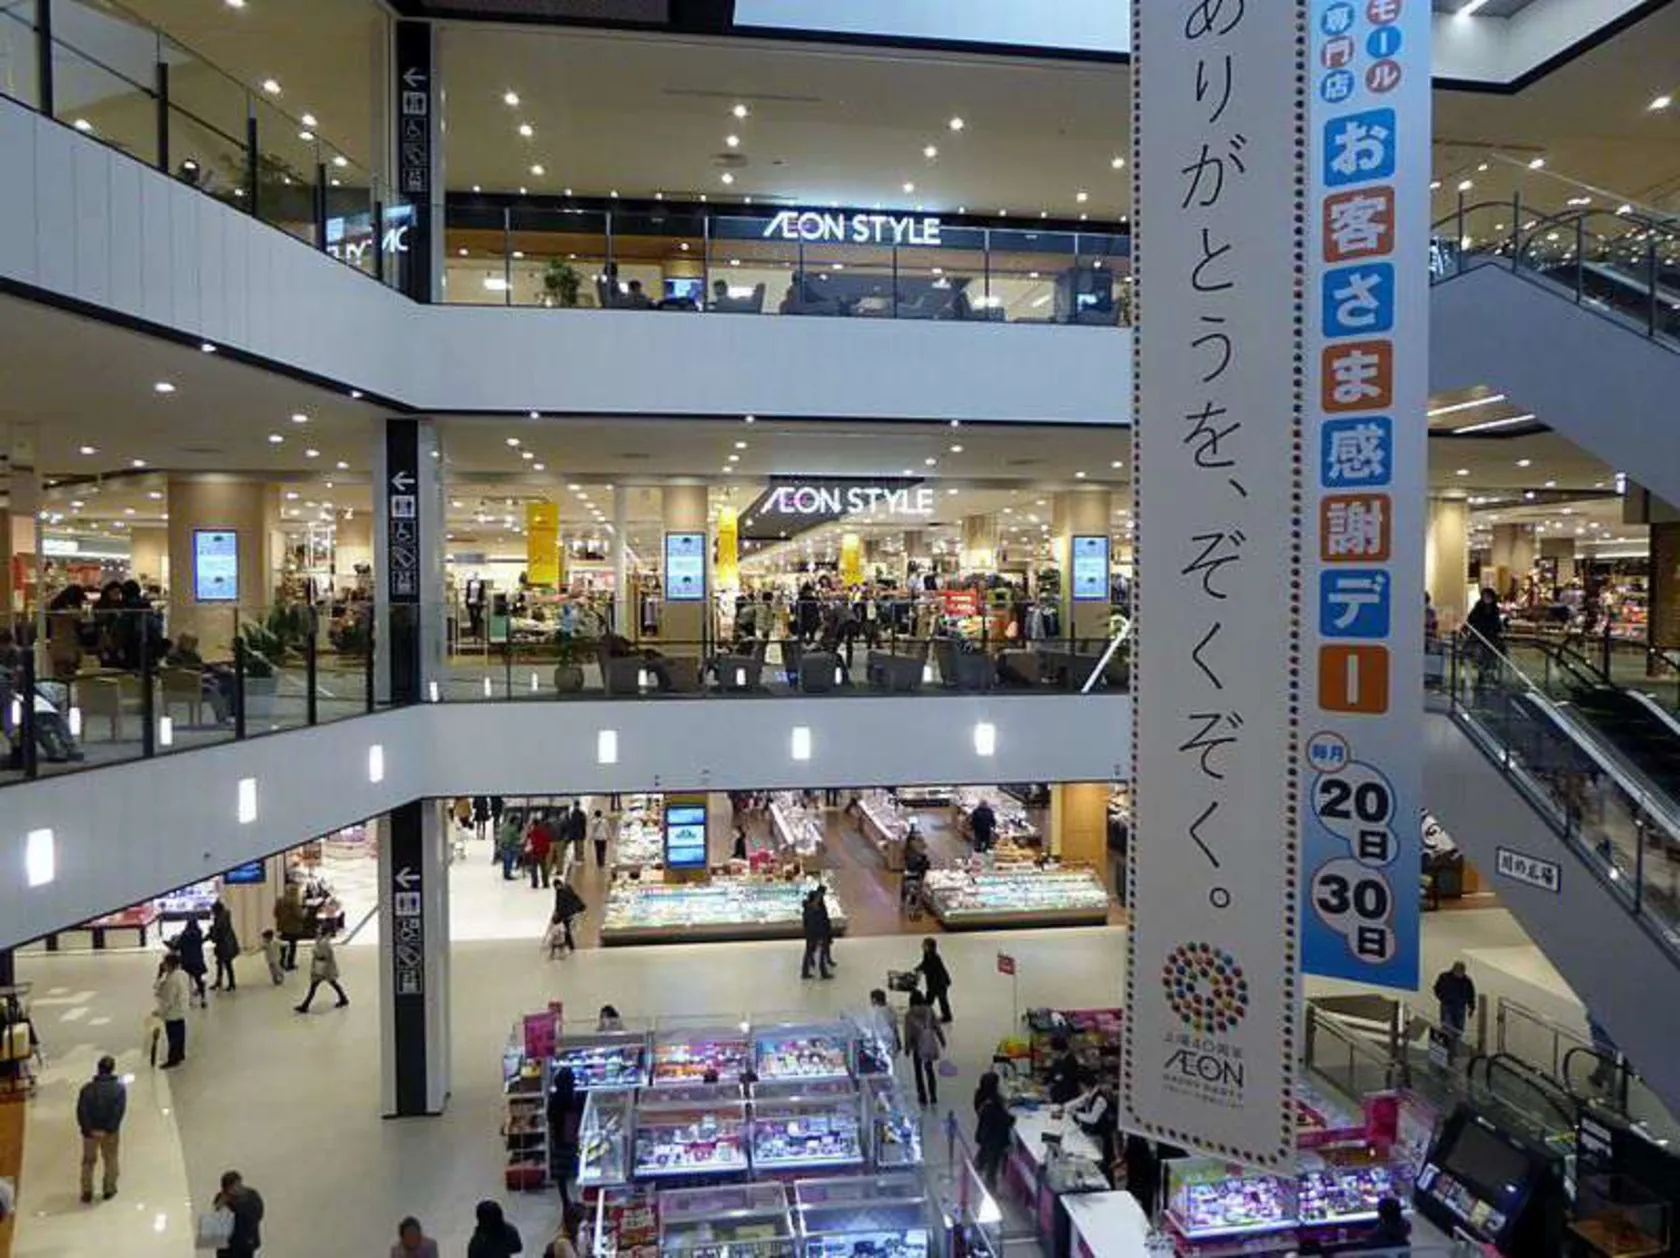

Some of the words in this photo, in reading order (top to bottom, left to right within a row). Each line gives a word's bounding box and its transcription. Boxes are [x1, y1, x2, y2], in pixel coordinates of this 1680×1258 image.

[852, 214, 942, 245] STYLE
[1328, 120, 1390, 705] お客さま感謝デー
[847, 487, 934, 514] STYLE
